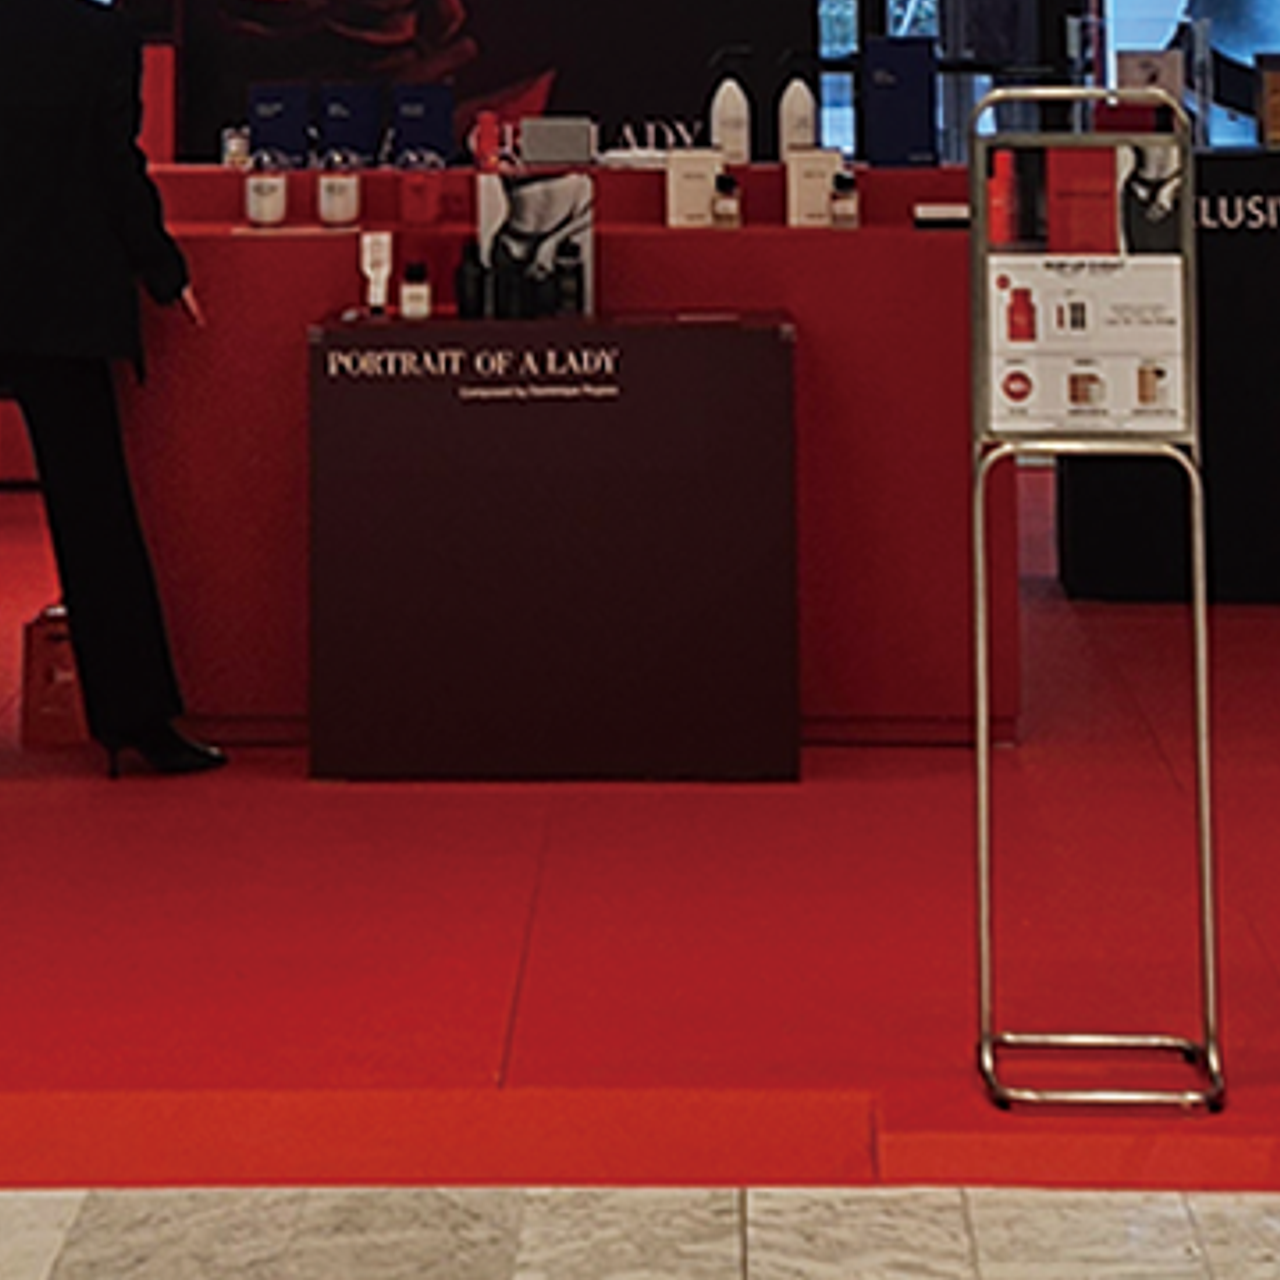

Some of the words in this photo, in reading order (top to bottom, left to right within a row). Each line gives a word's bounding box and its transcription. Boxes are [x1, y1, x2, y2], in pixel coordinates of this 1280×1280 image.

[327, 350, 466, 376] PORTRAIT
[475, 350, 514, 376] OF
[521, 350, 540, 376] A
[547, 349, 620, 375] LADY
